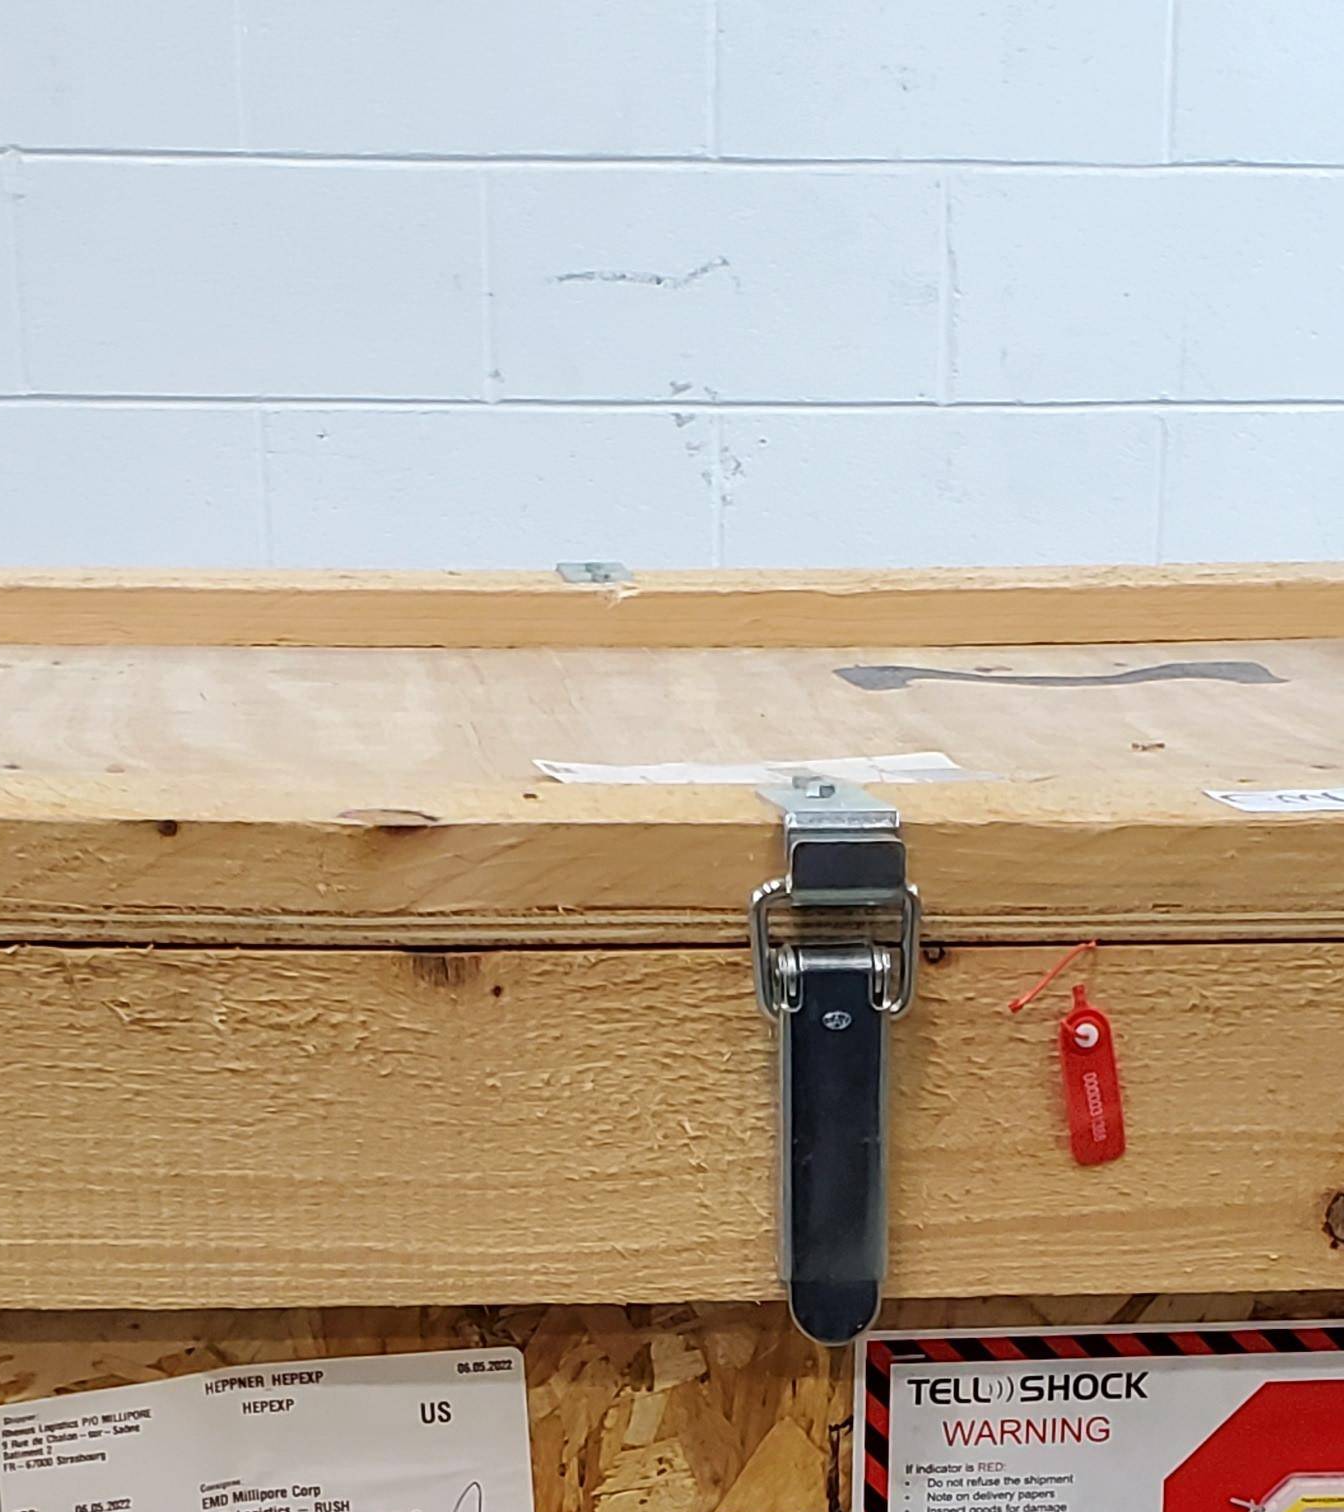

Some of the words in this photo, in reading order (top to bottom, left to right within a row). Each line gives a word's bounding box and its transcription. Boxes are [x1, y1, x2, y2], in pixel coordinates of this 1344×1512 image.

[907, 1377, 991, 1405] TELL
[1019, 1372, 1148, 1402] SHOCK
[242, 1399, 295, 1414] HEPEXP
[421, 1401, 452, 1424] US
[943, 1417, 1110, 1447] WARNING
[906, 1464, 913, 1474] If
[916, 1464, 962, 1474] indicator
[965, 1463, 974, 1473] is
[927, 1478, 943, 1488] Do
[946, 1478, 963, 1487] not
[967, 1476, 1000, 1487] refuse
[1004, 1476, 1021, 1486] the
[1024, 1474, 1074, 1486] shipment
[202, 1494, 228, 1510] EMD
[233, 1488, 288, 1505] Millipore
[292, 1486, 321, 1499] Corp
[927, 1493, 952, 1502] Note
[956, 1493, 970, 1502] on
[973, 1491, 1014, 1502] delivery
[1018, 1490, 1055, 1501] papers
